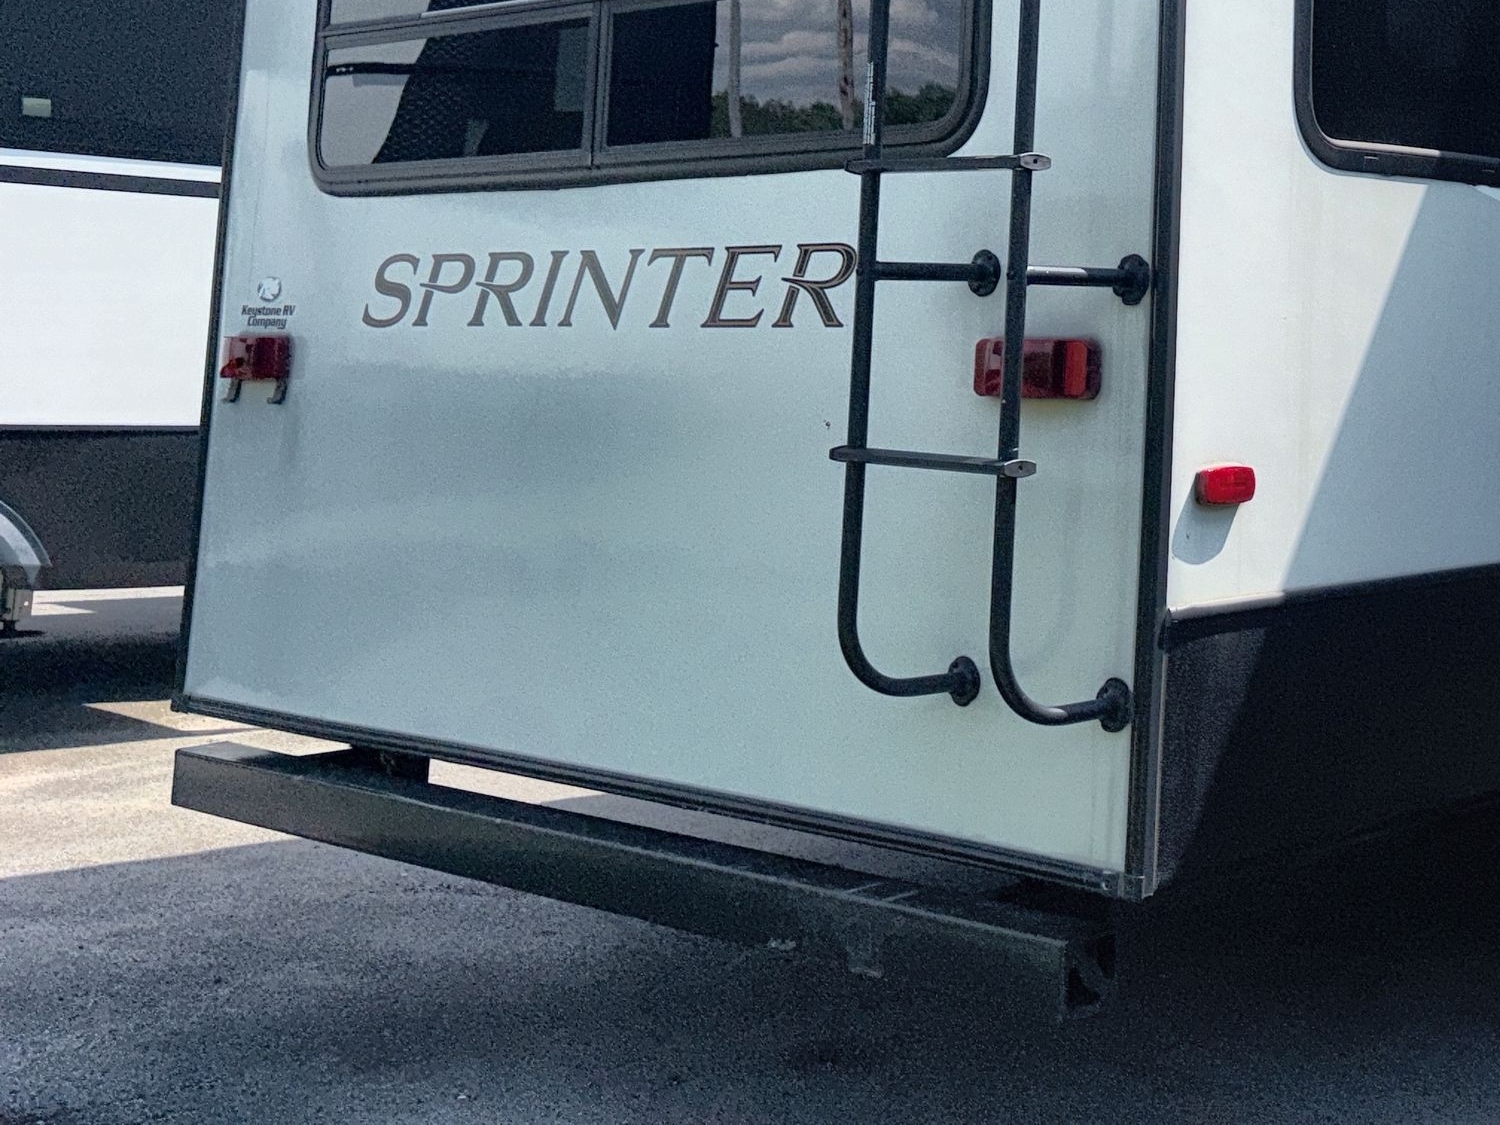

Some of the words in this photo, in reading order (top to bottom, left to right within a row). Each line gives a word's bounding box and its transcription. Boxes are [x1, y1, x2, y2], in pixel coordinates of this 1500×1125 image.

[362, 242, 858, 332] SPRINTER
[241, 305, 282, 316] Keystone
[282, 305, 296, 315] RV
[247, 316, 287, 329] Company
